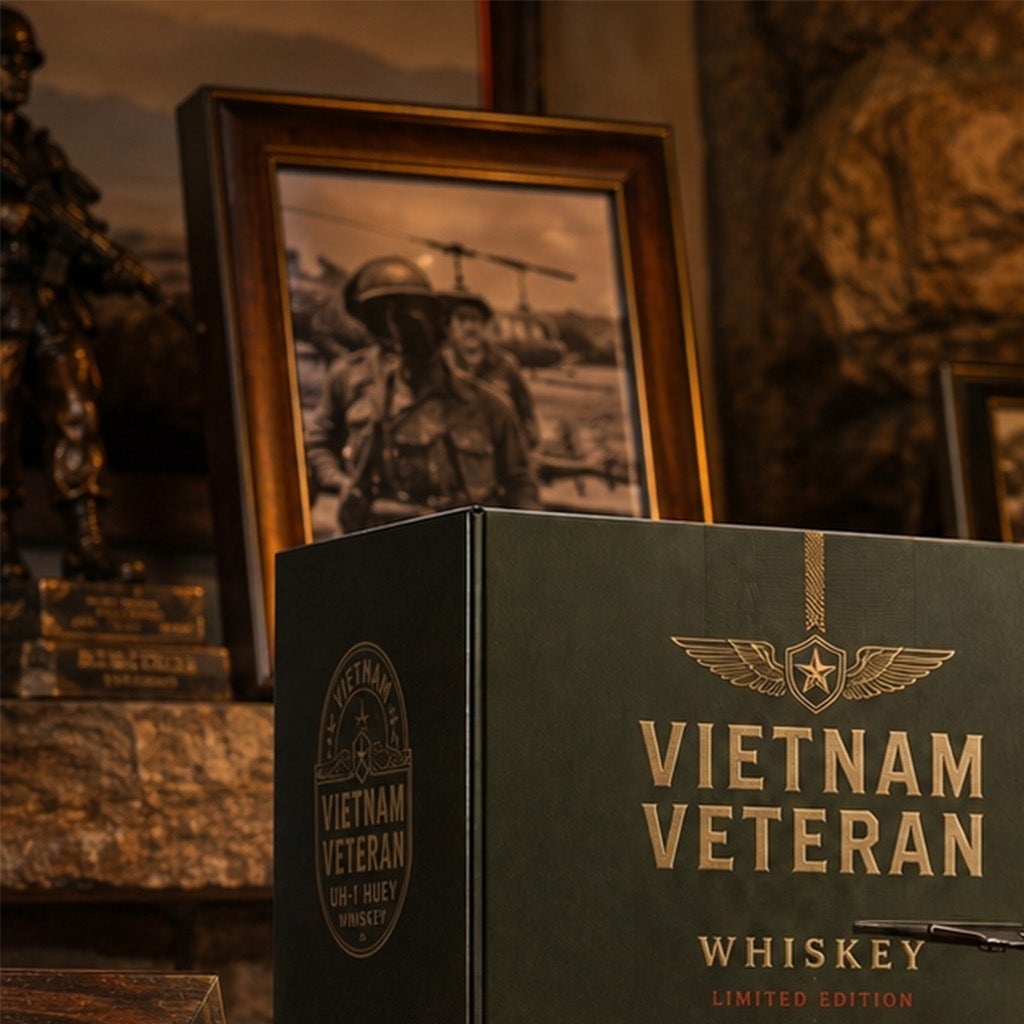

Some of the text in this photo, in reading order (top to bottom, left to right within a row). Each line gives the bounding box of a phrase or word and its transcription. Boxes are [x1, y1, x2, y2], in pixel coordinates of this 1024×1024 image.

[332, 659, 392, 709] VIETNAM
[639, 720, 984, 799] VIETNAM
[321, 783, 405, 832] VIETNAM
[322, 830, 405, 877] VETERAN
[642, 803, 984, 878] VETERAN
[363, 880, 398, 904] HUEY
[698, 935, 926, 971] WHISKEY
[711, 990, 914, 1009] LIMITED EDITION
